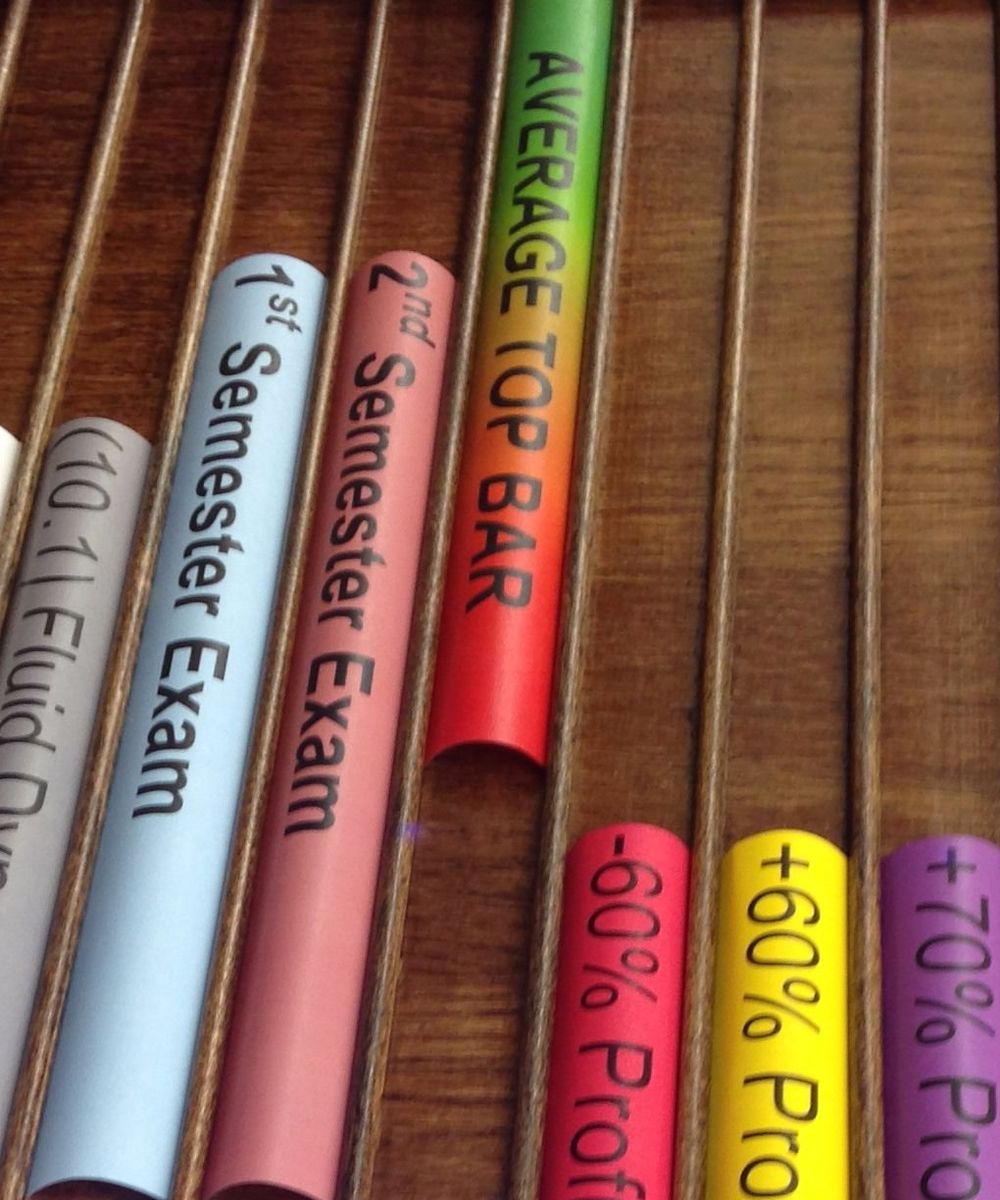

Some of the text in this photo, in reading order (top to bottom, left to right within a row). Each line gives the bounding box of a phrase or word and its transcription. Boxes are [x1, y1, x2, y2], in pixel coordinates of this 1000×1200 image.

[465, 50, 584, 612] AVERAGE TOP BAR
[132, 263, 303, 819] 1st Semester Exam
[284, 261, 436, 837] 2nd Semester Exam
[579, 835, 663, 1011] -60%
[742, 841, 822, 1042] +60%
[915, 845, 998, 1047] +70%
